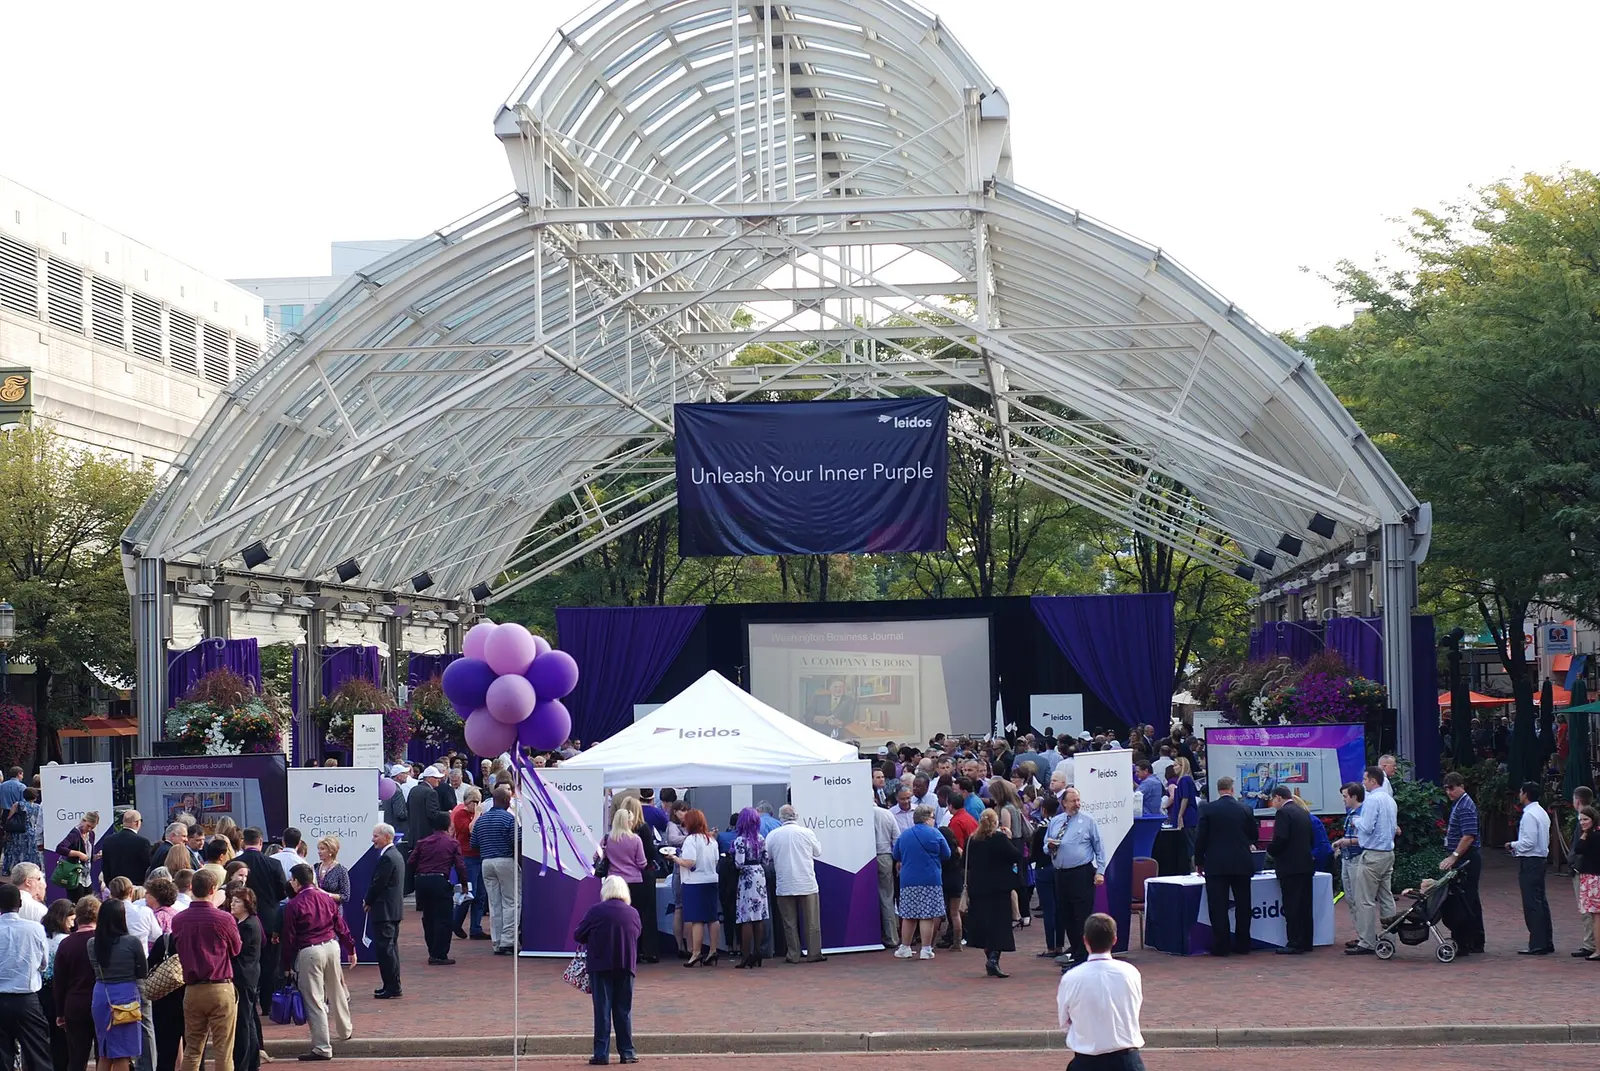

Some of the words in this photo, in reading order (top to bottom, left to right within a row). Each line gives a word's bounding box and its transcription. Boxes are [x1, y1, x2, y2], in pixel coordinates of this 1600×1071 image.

[894, 416, 932, 428] leidos
[691, 465, 765, 484] Unleash
[770, 465, 813, 482] Your
[819, 464, 867, 481] Inner
[873, 461, 933, 484] Purple
[771, 633, 825, 643] Washngton
[826, 632, 868, 641] Business
[870, 631, 904, 641] Journal
[801, 657, 808, 666] A
[811, 657, 868, 666] COMPANY
[871, 658, 881, 667] IS
[883, 659, 913, 667] BORN
[679, 727, 741, 739] leidos
[1215, 733, 1254, 742] Washington
[1255, 732, 1284, 740] Bness
[1285, 731, 1310, 739] Journal
[1244, 750, 1285, 758] COMPANY
[142, 763, 179, 772] Washington
[210, 761, 233, 769] Journal
[1097, 768, 1118, 779] leidos
[69, 776, 94, 784] leidos
[824, 776, 852, 786] leidos
[324, 784, 355, 793] leidos
[555, 783, 583, 792] leidos
[299, 813, 368, 826] Registration/
[803, 815, 864, 829] Welcome
[1096, 814, 1118, 825] eck-In
[1250, 900, 1285, 920] eid
